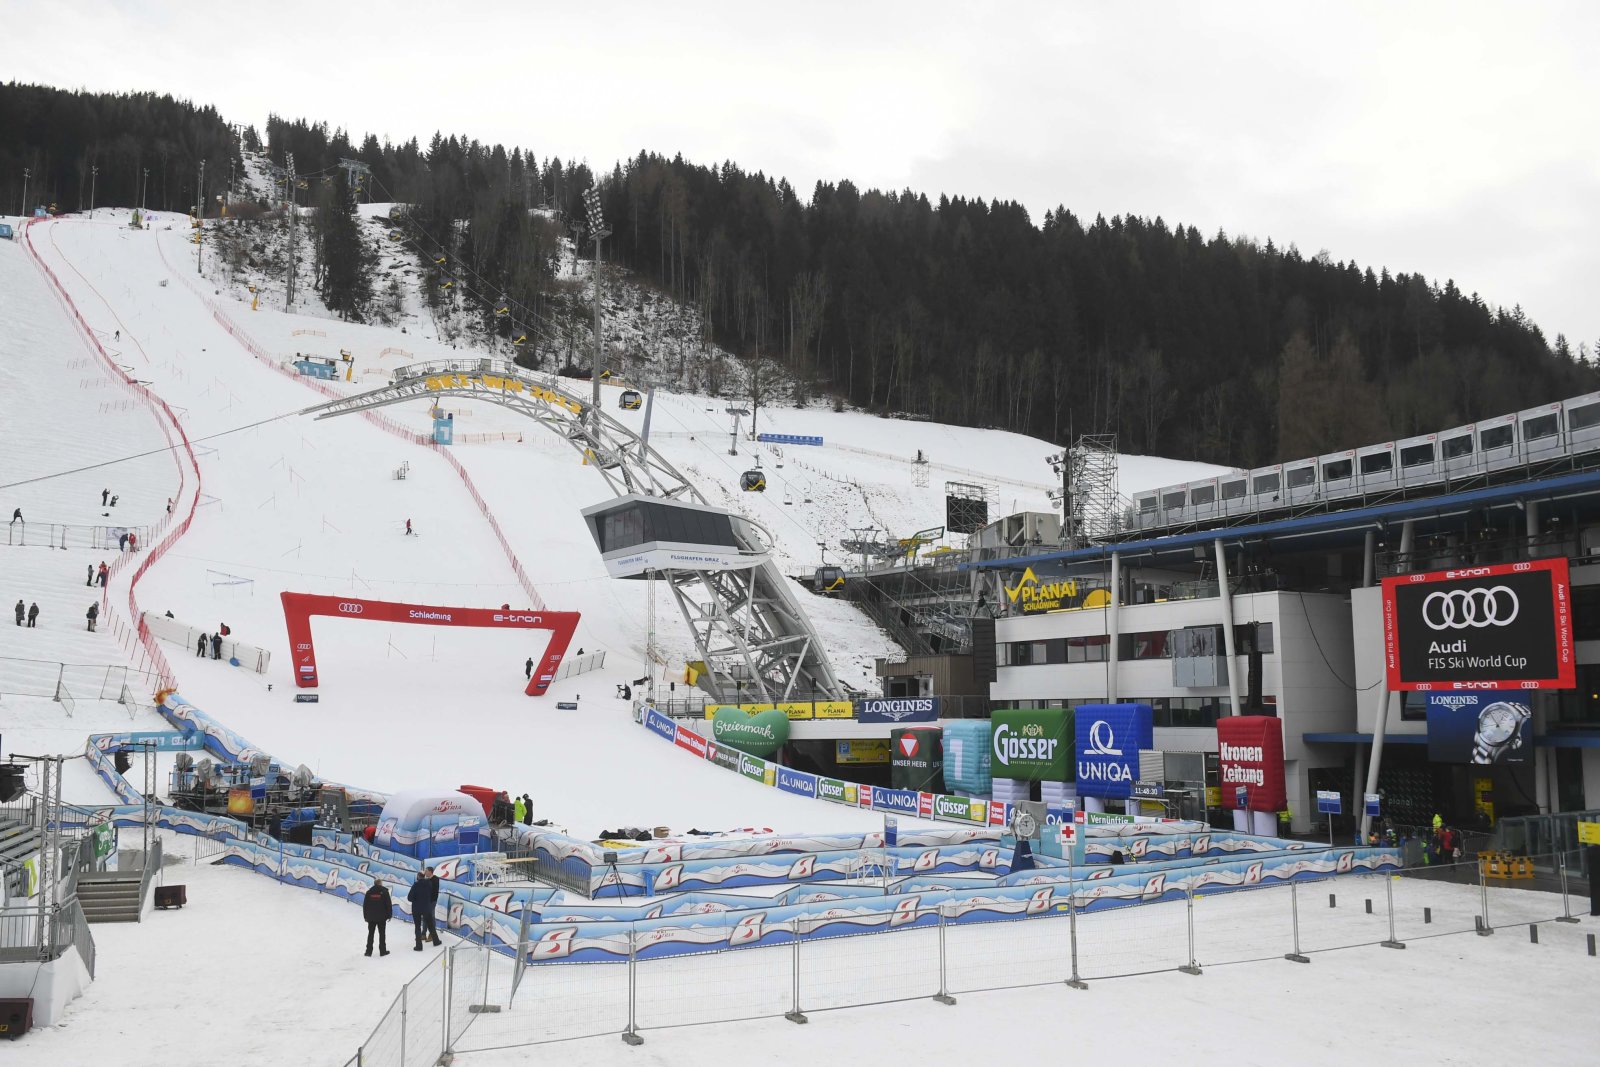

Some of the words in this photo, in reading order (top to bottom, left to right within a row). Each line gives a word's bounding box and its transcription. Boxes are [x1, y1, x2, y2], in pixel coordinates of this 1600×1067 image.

[1446, 567, 1491, 579] e-tron
[1022, 580, 1077, 602] PLANAI
[1557, 583, 1566, 600] Audi
[1023, 599, 1060, 611] SCHLADMING
[409, 609, 452, 621] Schladming
[493, 613, 542, 624] e-tron
[1560, 615, 1568, 626] Ski
[1561, 627, 1569, 647] World
[1428, 639, 1467, 654] Audi
[1428, 658, 1446, 669] FIS
[1448, 656, 1464, 669] Ski
[1467, 655, 1502, 668] World
[1504, 654, 1527, 669] Cup
[1453, 681, 1497, 689] e-tron
[864, 699, 933, 713] LONGINES
[1430, 695, 1479, 705] LONGINES
[656, 720, 674, 737] UNIQA
[715, 720, 775, 740] Steiermark
[994, 723, 1058, 766] Gösser
[1220, 742, 1263, 762] Kronen
[742, 757, 763, 776] Gösser
[892, 759, 911, 767] UNSER
[949, 739, 963, 780] 1
[1079, 761, 1133, 782] UNIQA
[1222, 764, 1264, 787] Zeitung
[790, 779, 814, 792] UNIQA
[819, 777, 843, 796] Gösser
[887, 793, 918, 808] UNIQA
[936, 794, 969, 816] Gösser
